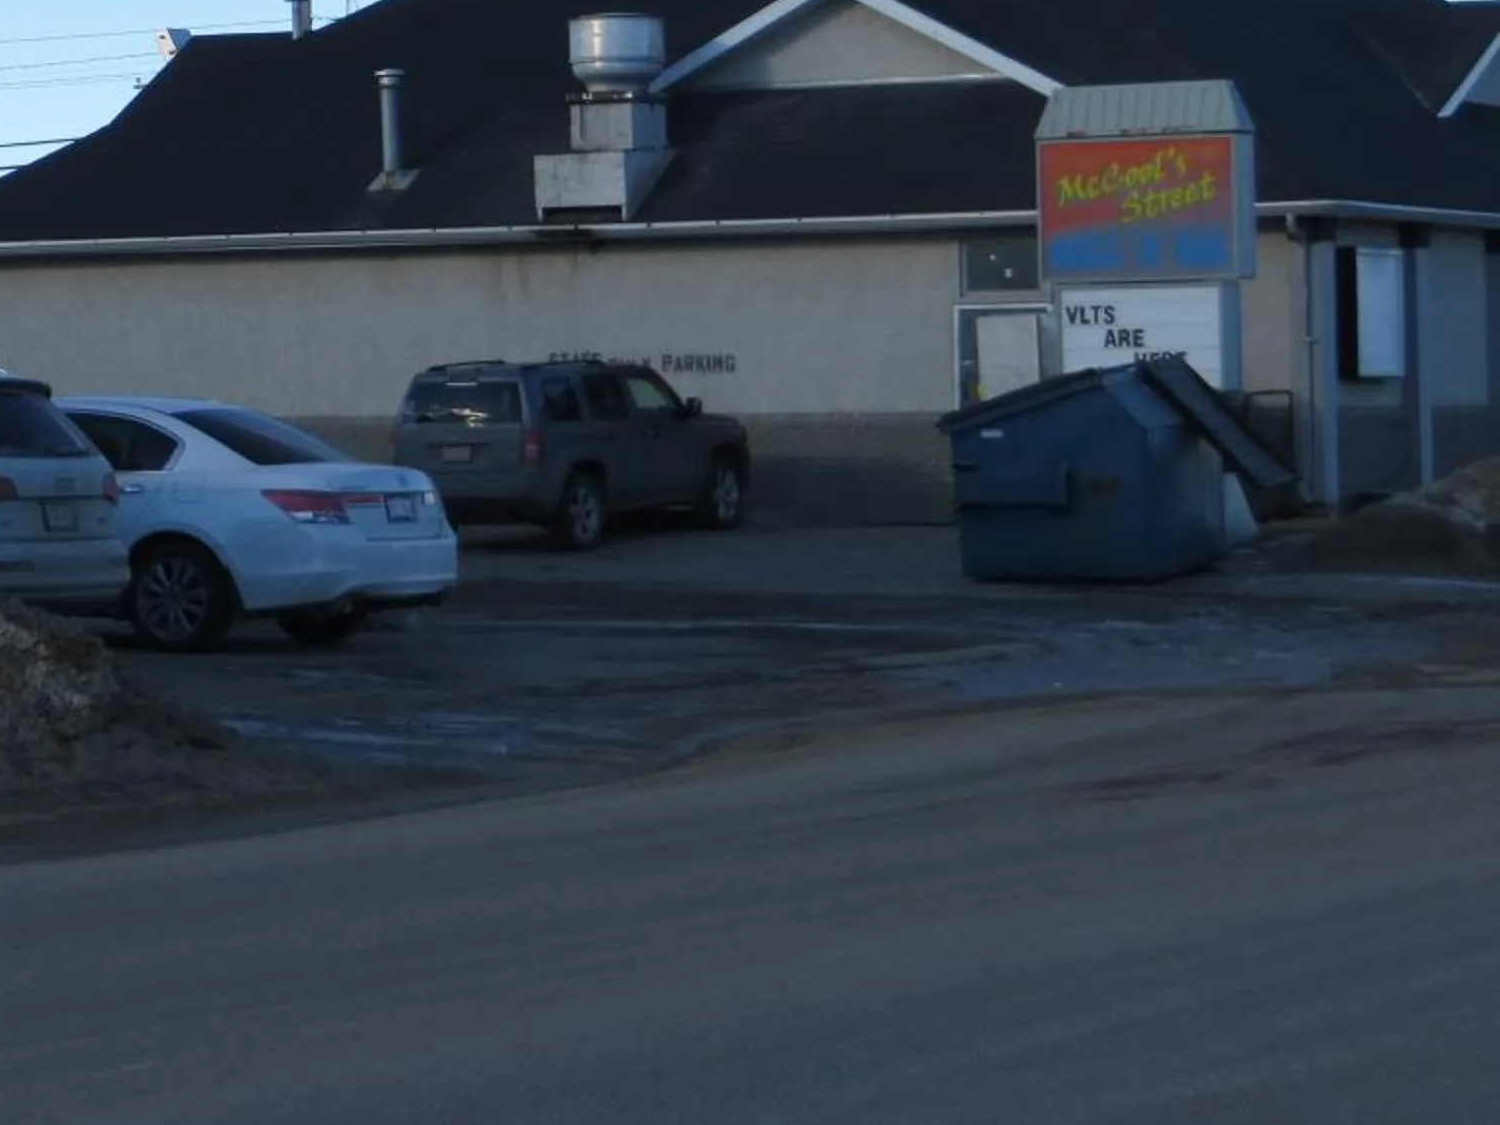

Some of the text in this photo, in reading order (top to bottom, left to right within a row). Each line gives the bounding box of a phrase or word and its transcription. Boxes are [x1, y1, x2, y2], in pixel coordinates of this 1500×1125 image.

[1121, 173, 1216, 222] Street
[1064, 305, 1117, 325] VLTS
[1103, 328, 1145, 348] ARE
[661, 353, 736, 374] PARKING
